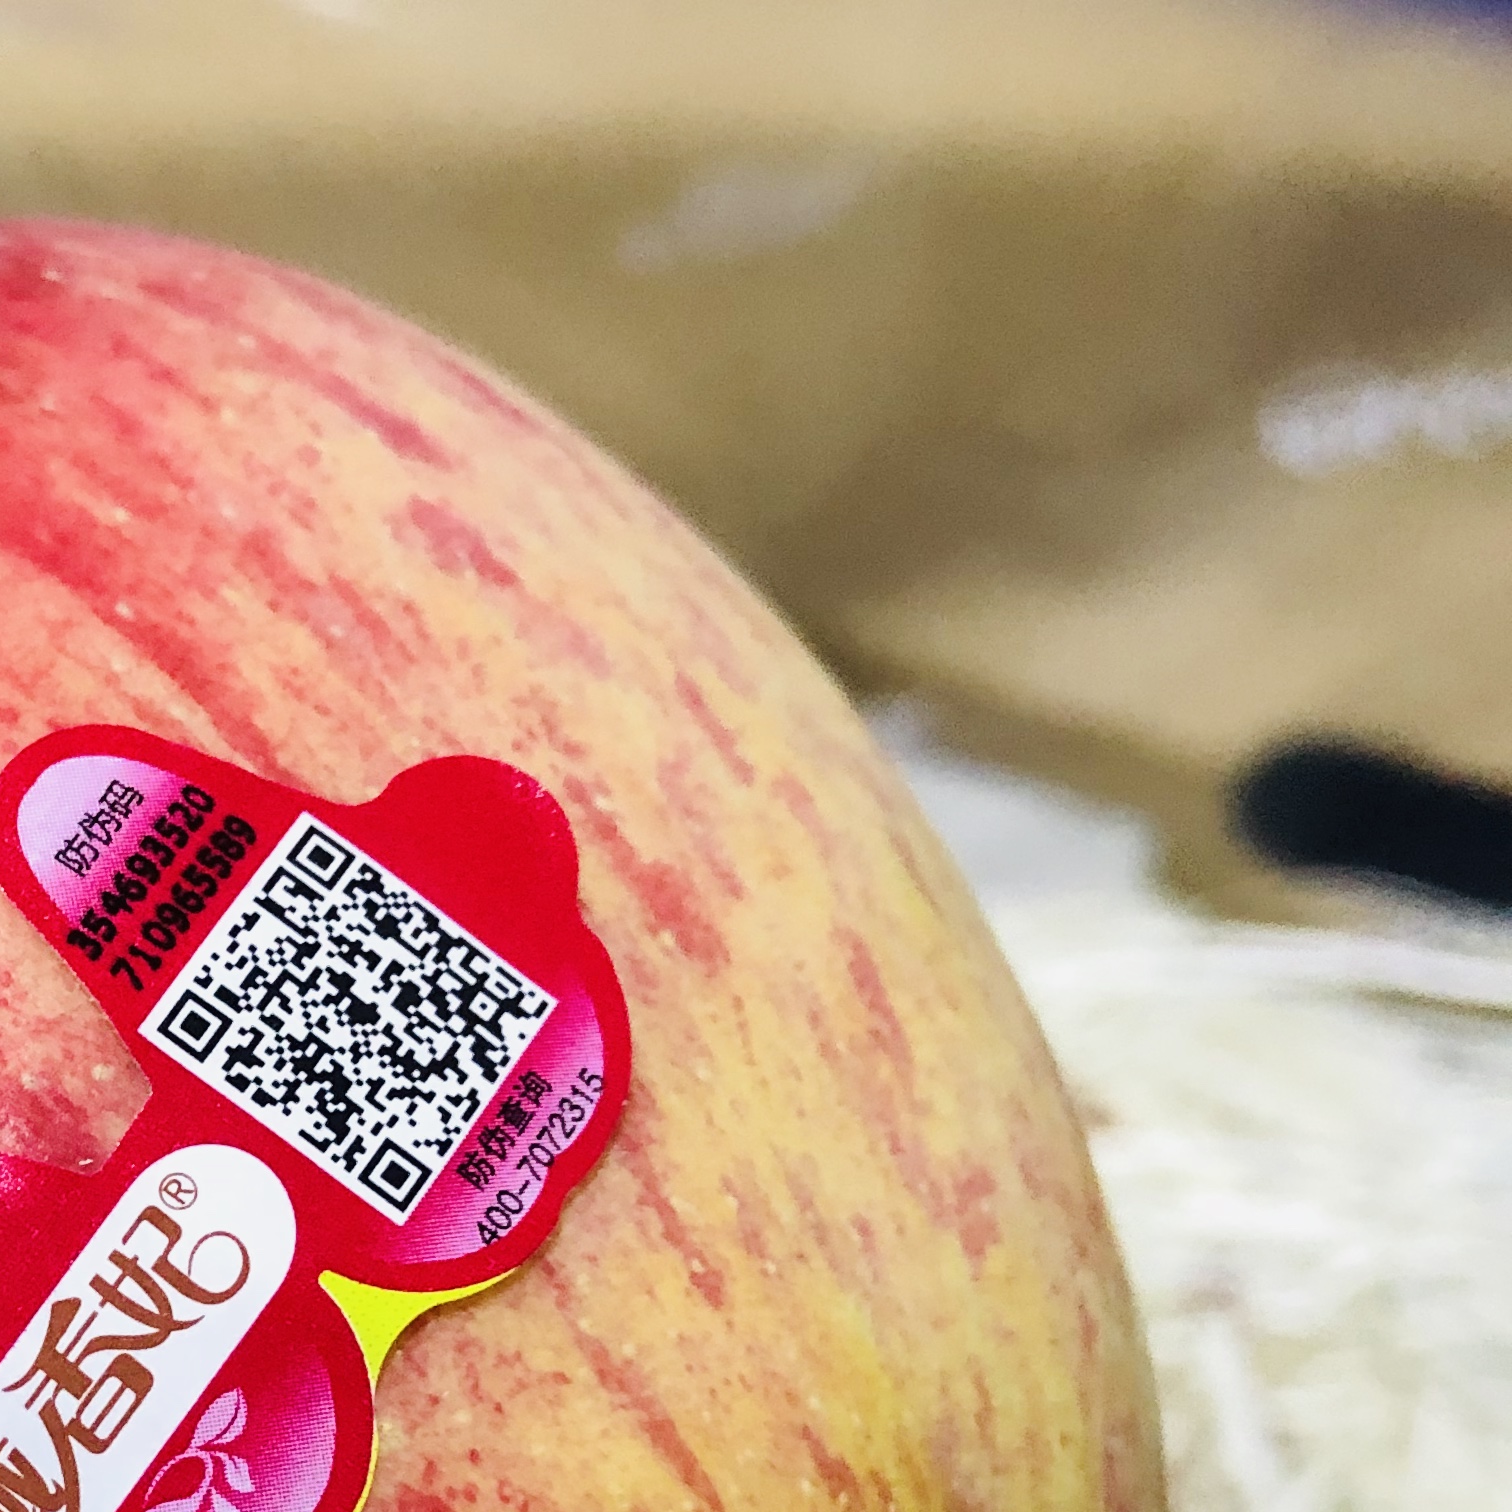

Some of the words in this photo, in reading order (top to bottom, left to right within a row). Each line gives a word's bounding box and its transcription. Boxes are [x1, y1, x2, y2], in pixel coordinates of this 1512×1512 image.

[54, 779, 145, 878] 防伪码
[66, 783, 216, 962] 354693520
[109, 814, 257, 991] 710965589
[456, 1070, 553, 1192] 防伪查询
[477, 1067, 605, 1245] 400-7072315
